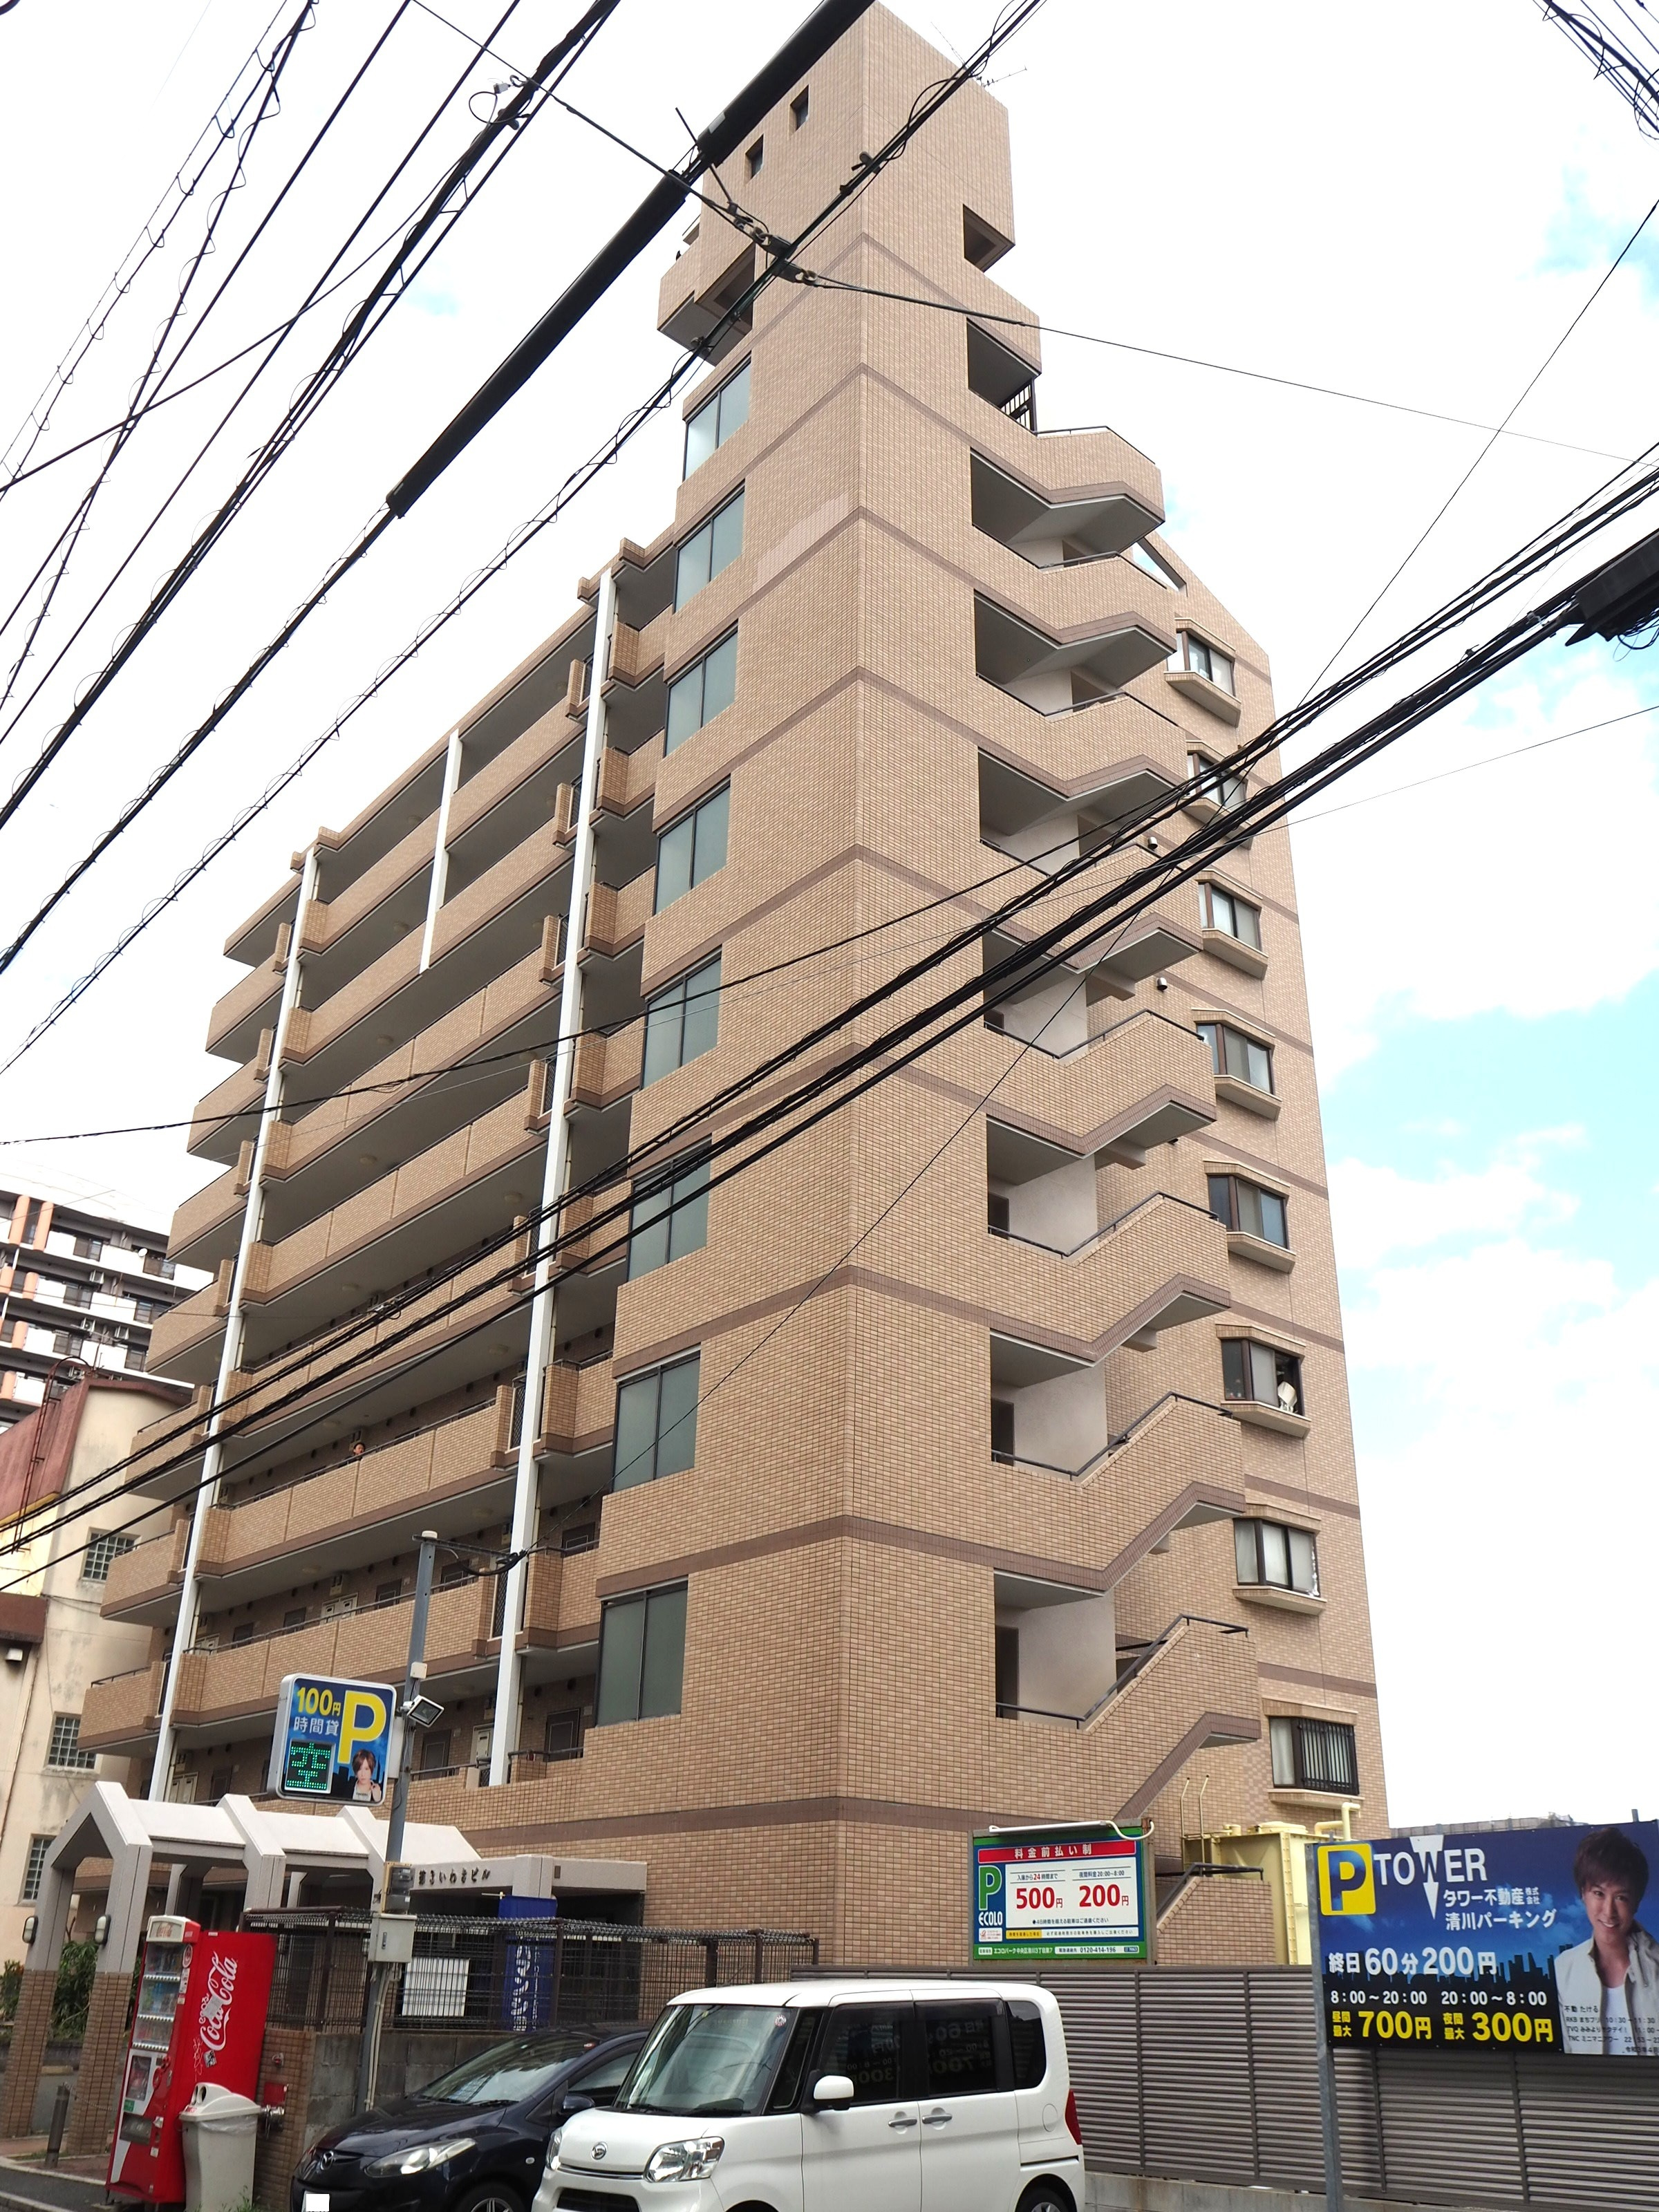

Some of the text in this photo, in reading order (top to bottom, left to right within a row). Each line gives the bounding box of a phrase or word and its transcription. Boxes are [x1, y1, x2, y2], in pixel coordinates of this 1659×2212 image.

[297, 1687, 341, 1716] 100円
[293, 1716, 339, 1736] 時間貸
[337, 1690, 387, 1764] P
[287, 1743, 331, 1790] 空
[1015, 1844, 1091, 1859] 料金前払い制
[979, 1865, 1002, 1911] P
[1328, 1850, 1367, 1911] P
[1015, 1887, 1063, 1909] 500円
[1079, 1884, 1129, 1907] 200円
[1443, 1887, 1525, 1907] タワー不動産
[979, 1911, 1002, 1927] ECOLO
[1445, 1909, 1557, 1931] 清川パーキング
[1358, 2011, 1432, 2039] 700円
[1443, 2012, 1463, 2025] 夜間
[1472, 2012, 1553, 2042] 300円
